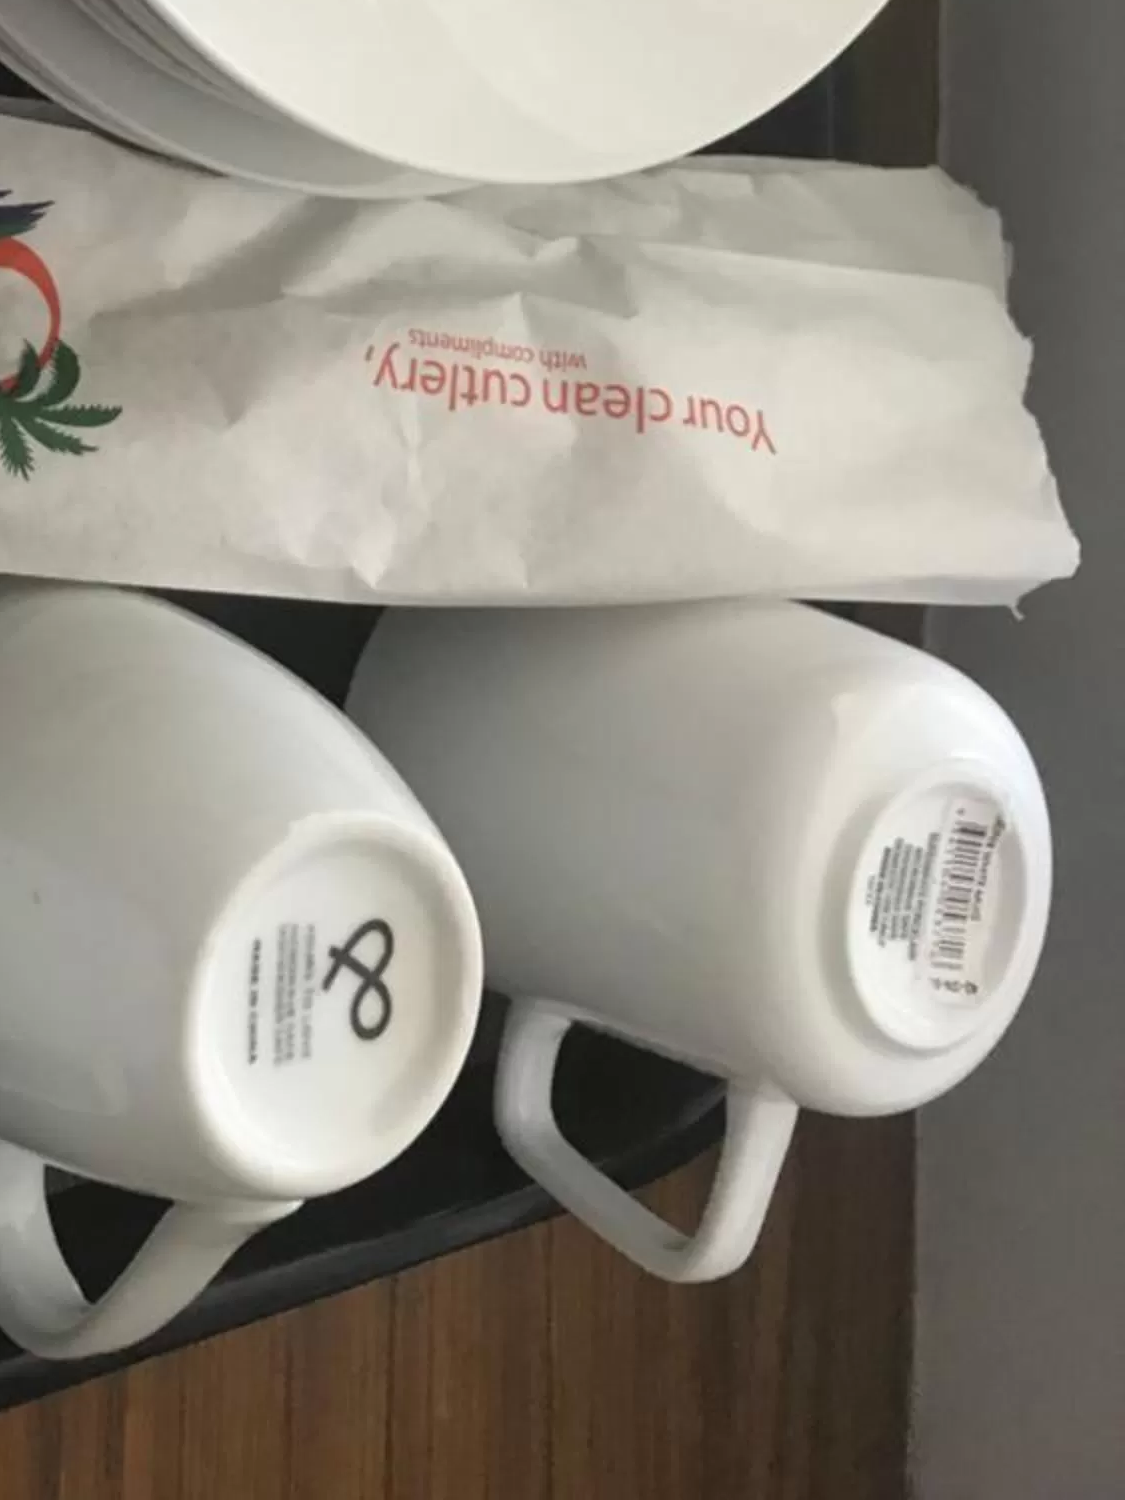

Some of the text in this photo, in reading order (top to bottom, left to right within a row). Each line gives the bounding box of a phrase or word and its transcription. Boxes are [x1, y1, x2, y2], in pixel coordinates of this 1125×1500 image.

[408, 327, 588, 372] with compliments
[365, 342, 778, 455] Your clean cutlery,
